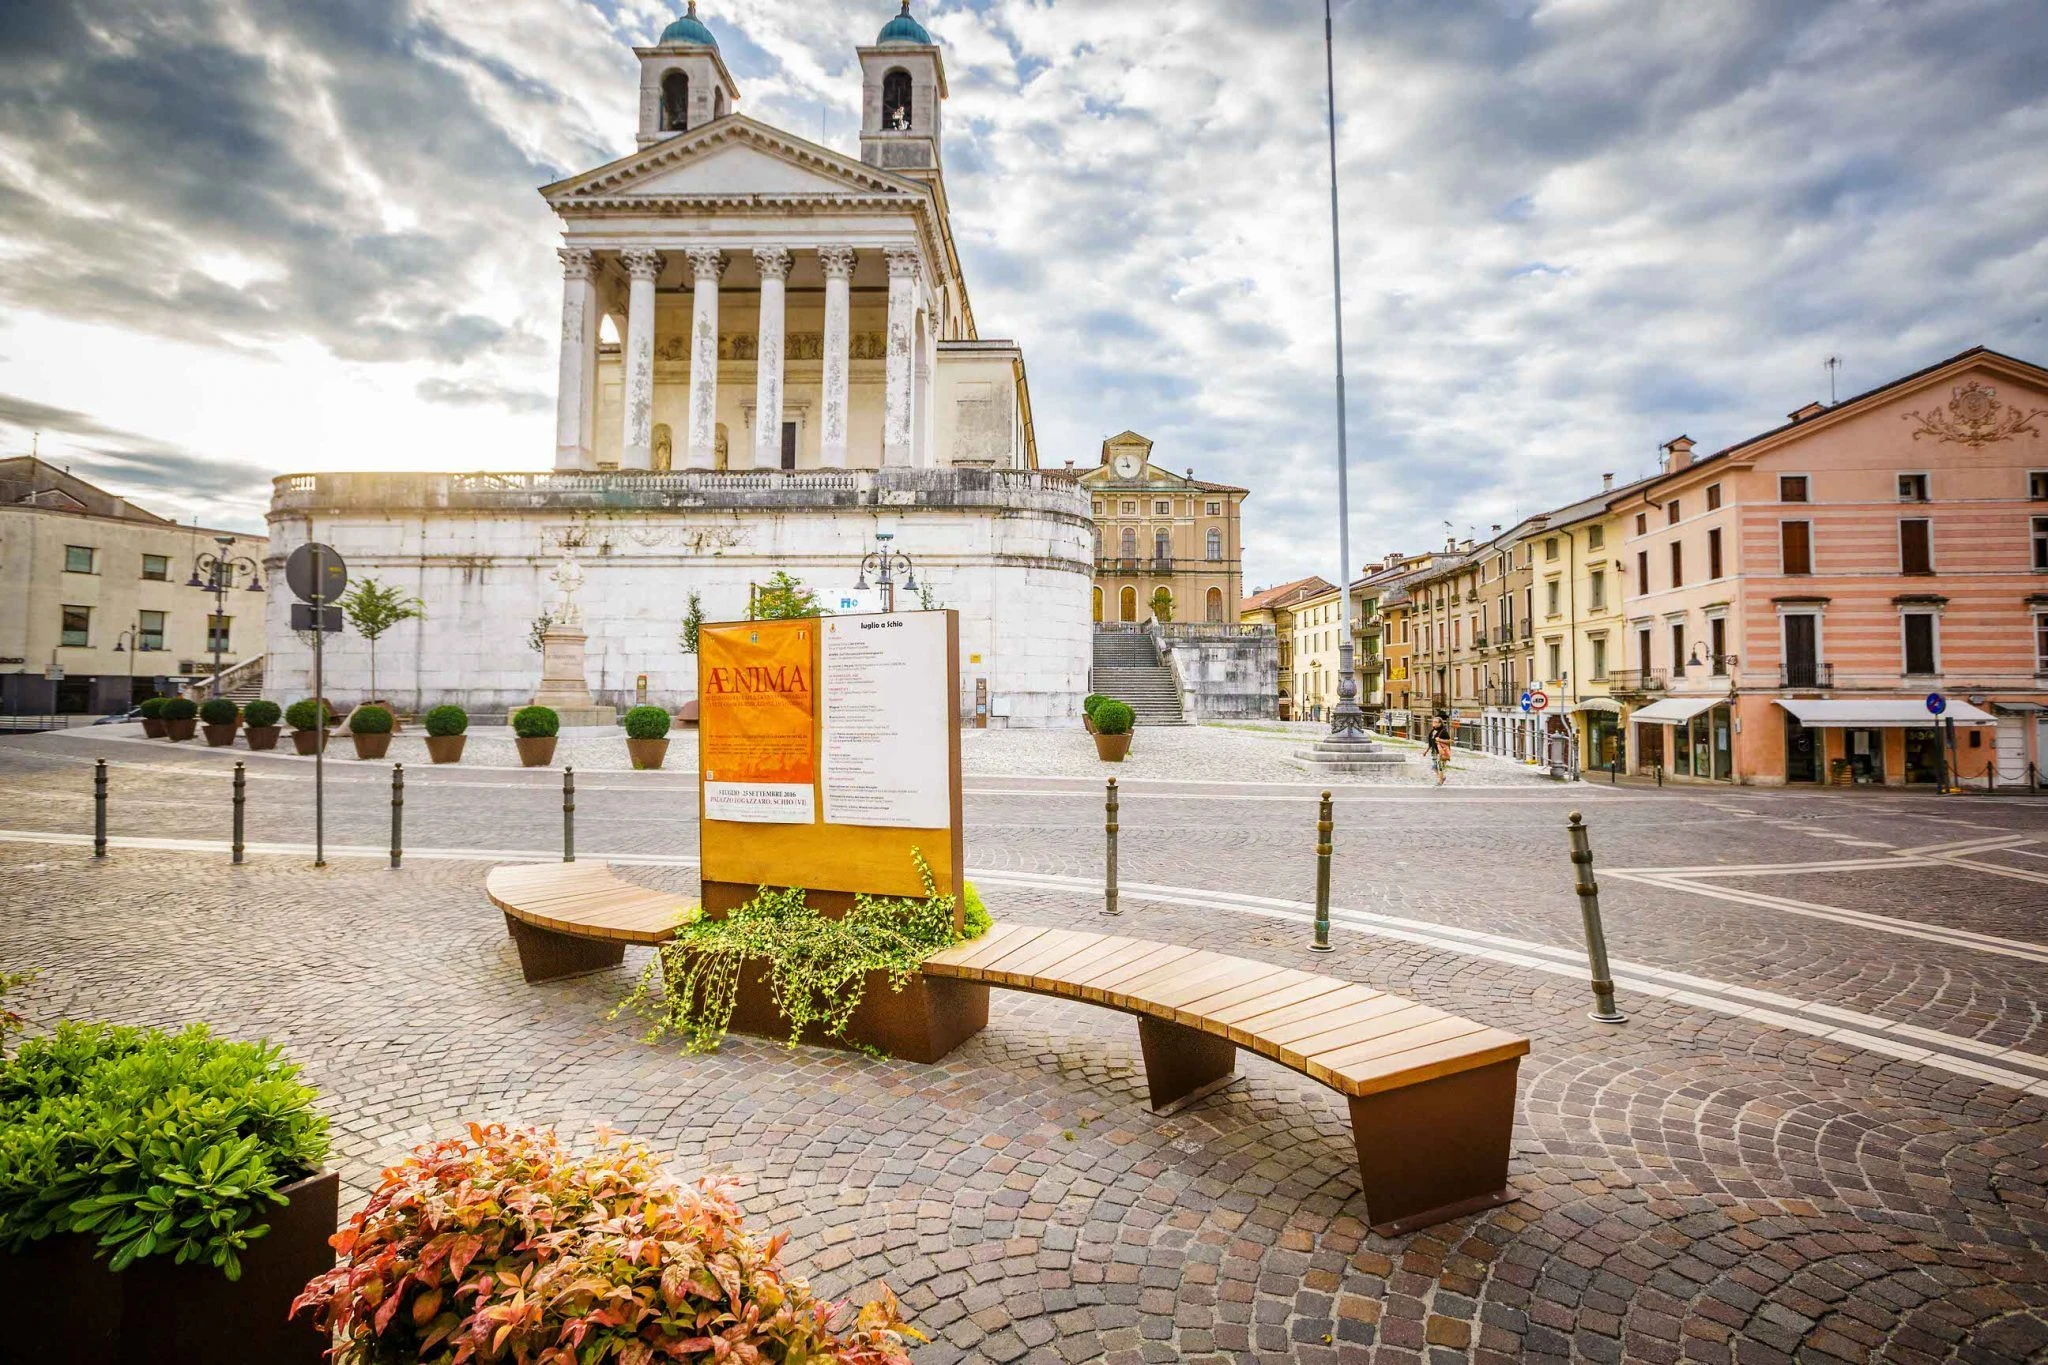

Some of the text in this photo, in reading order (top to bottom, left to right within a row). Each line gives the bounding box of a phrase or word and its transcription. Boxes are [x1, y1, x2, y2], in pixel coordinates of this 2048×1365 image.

[861, 622, 880, 630] luglio
[887, 620, 903, 628] Schio
[705, 665, 808, 693] ÆNIMA
